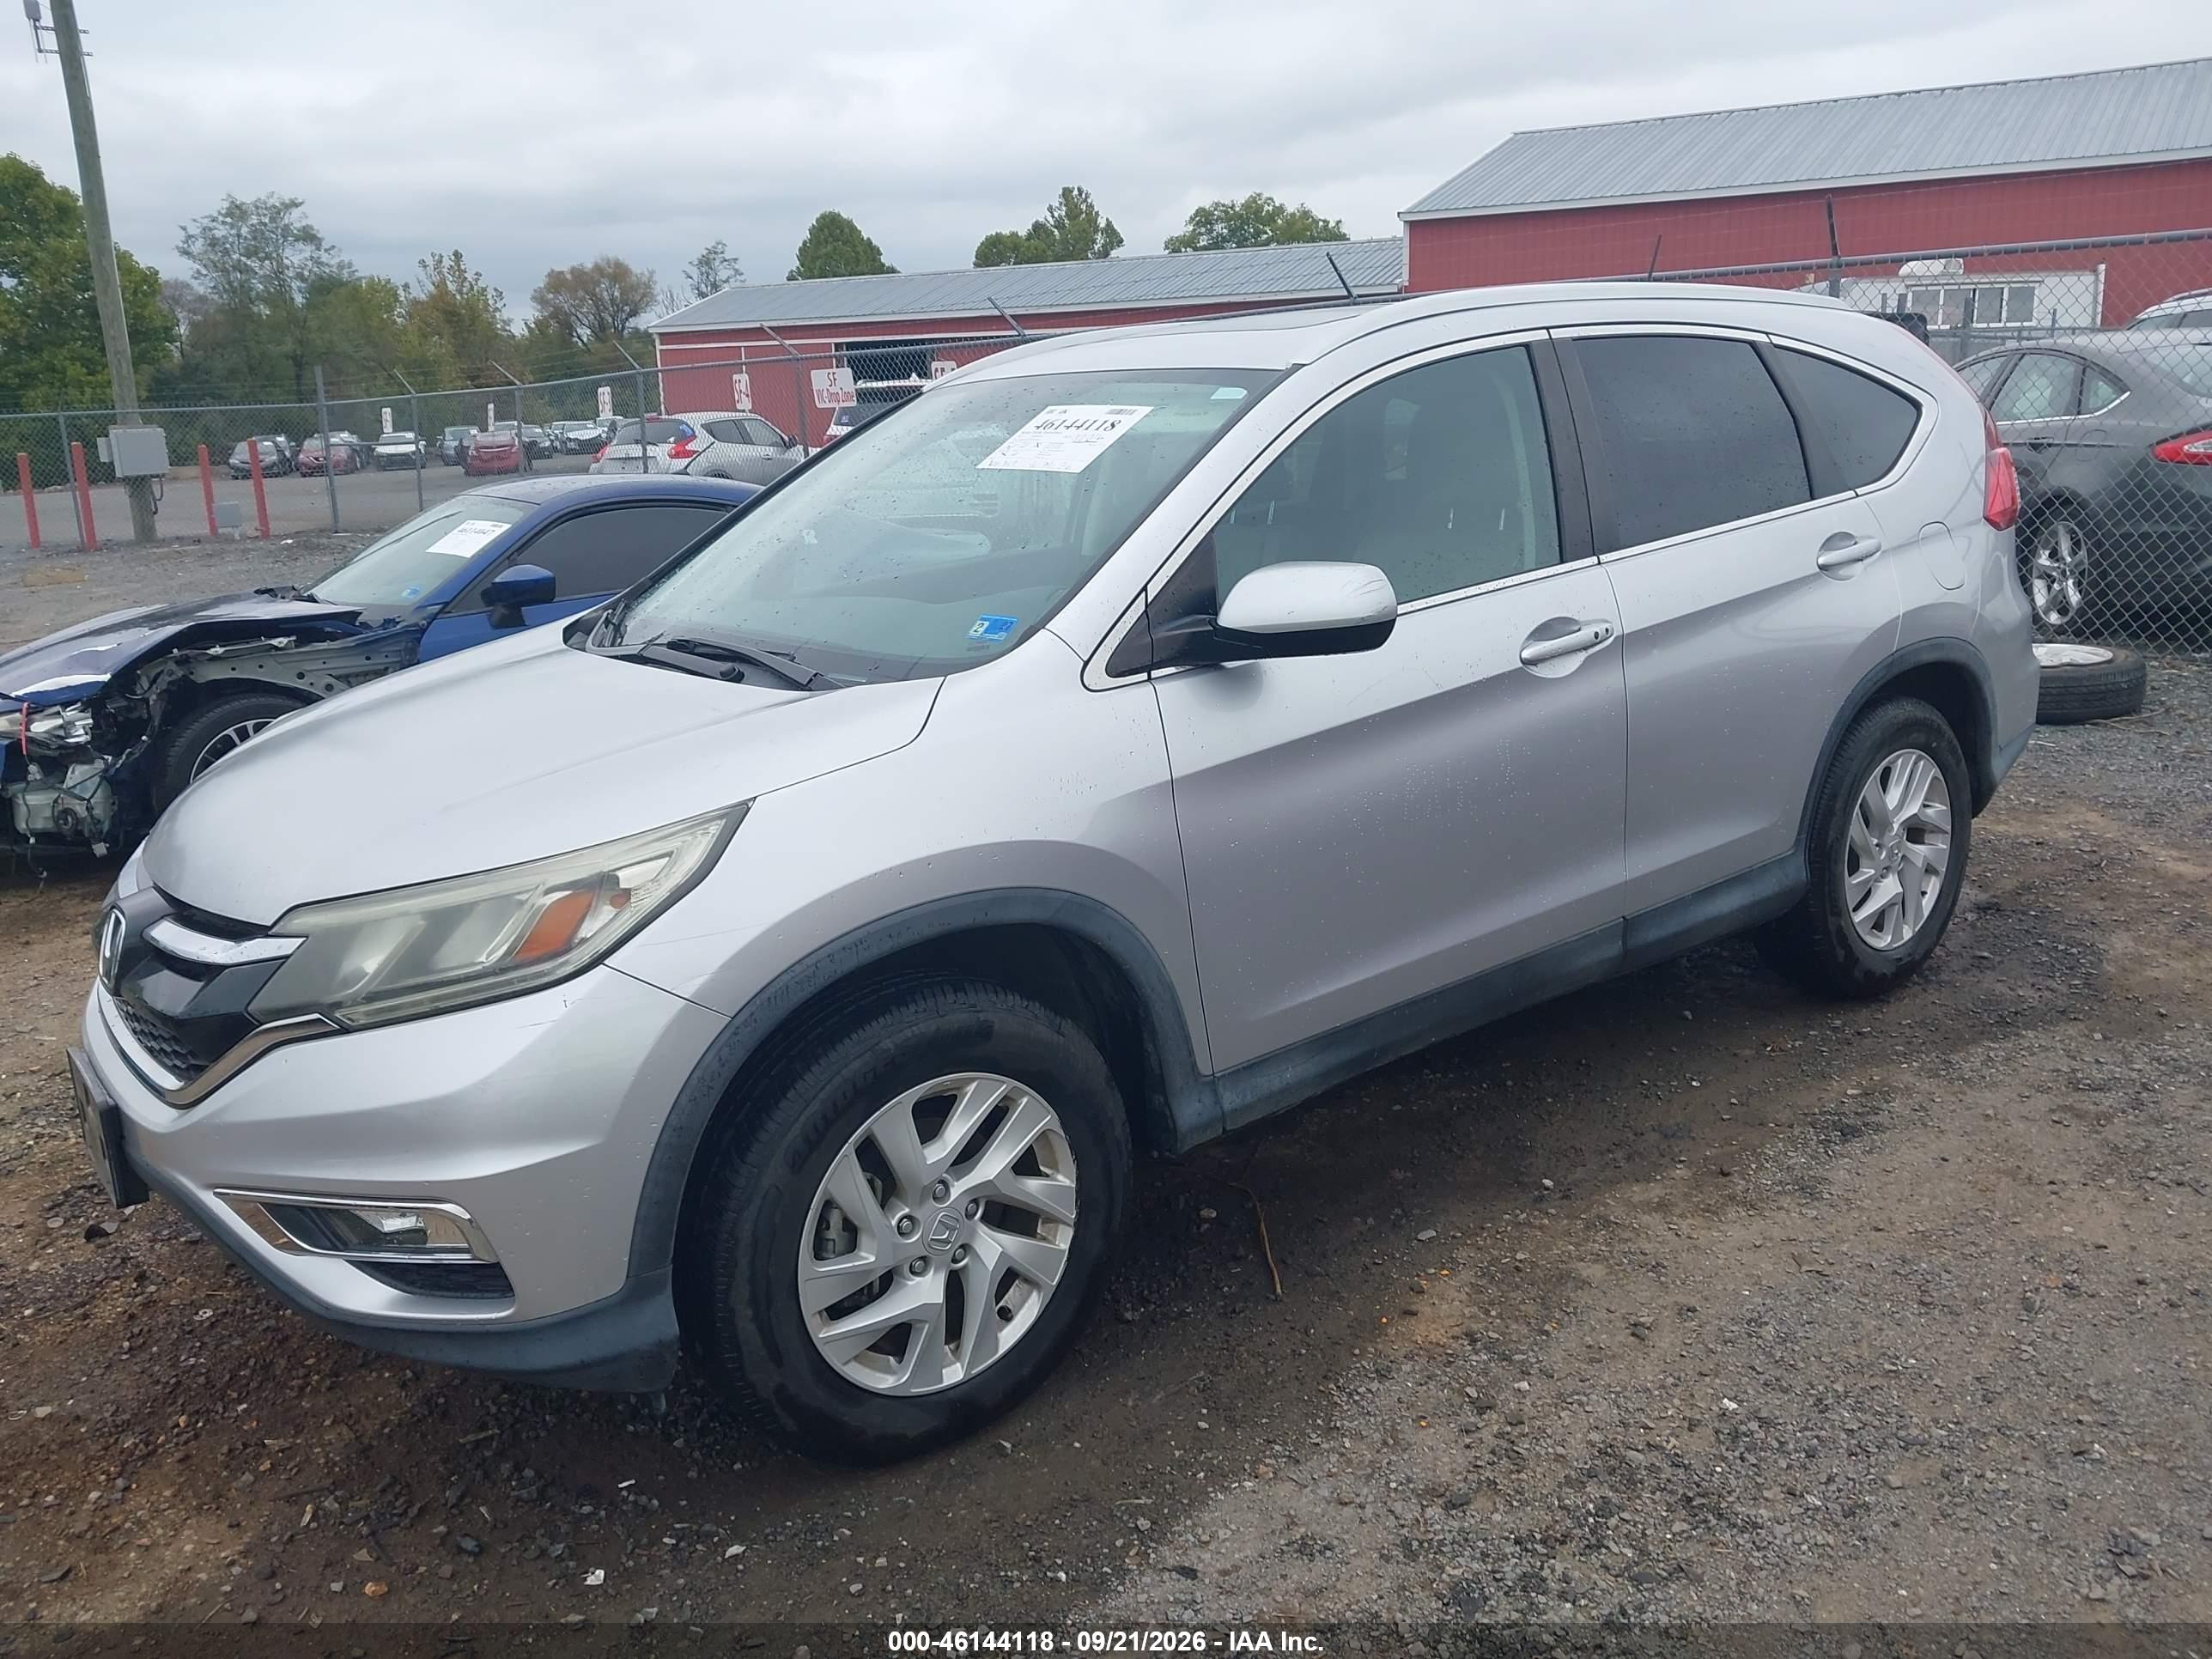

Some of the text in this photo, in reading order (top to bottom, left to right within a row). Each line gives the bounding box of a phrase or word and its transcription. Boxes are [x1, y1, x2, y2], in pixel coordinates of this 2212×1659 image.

[827, 372, 837, 386] SF
[840, 387, 855, 403] Zone
[1034, 419, 1121, 431] 46144118
[974, 623, 985, 633] 2
